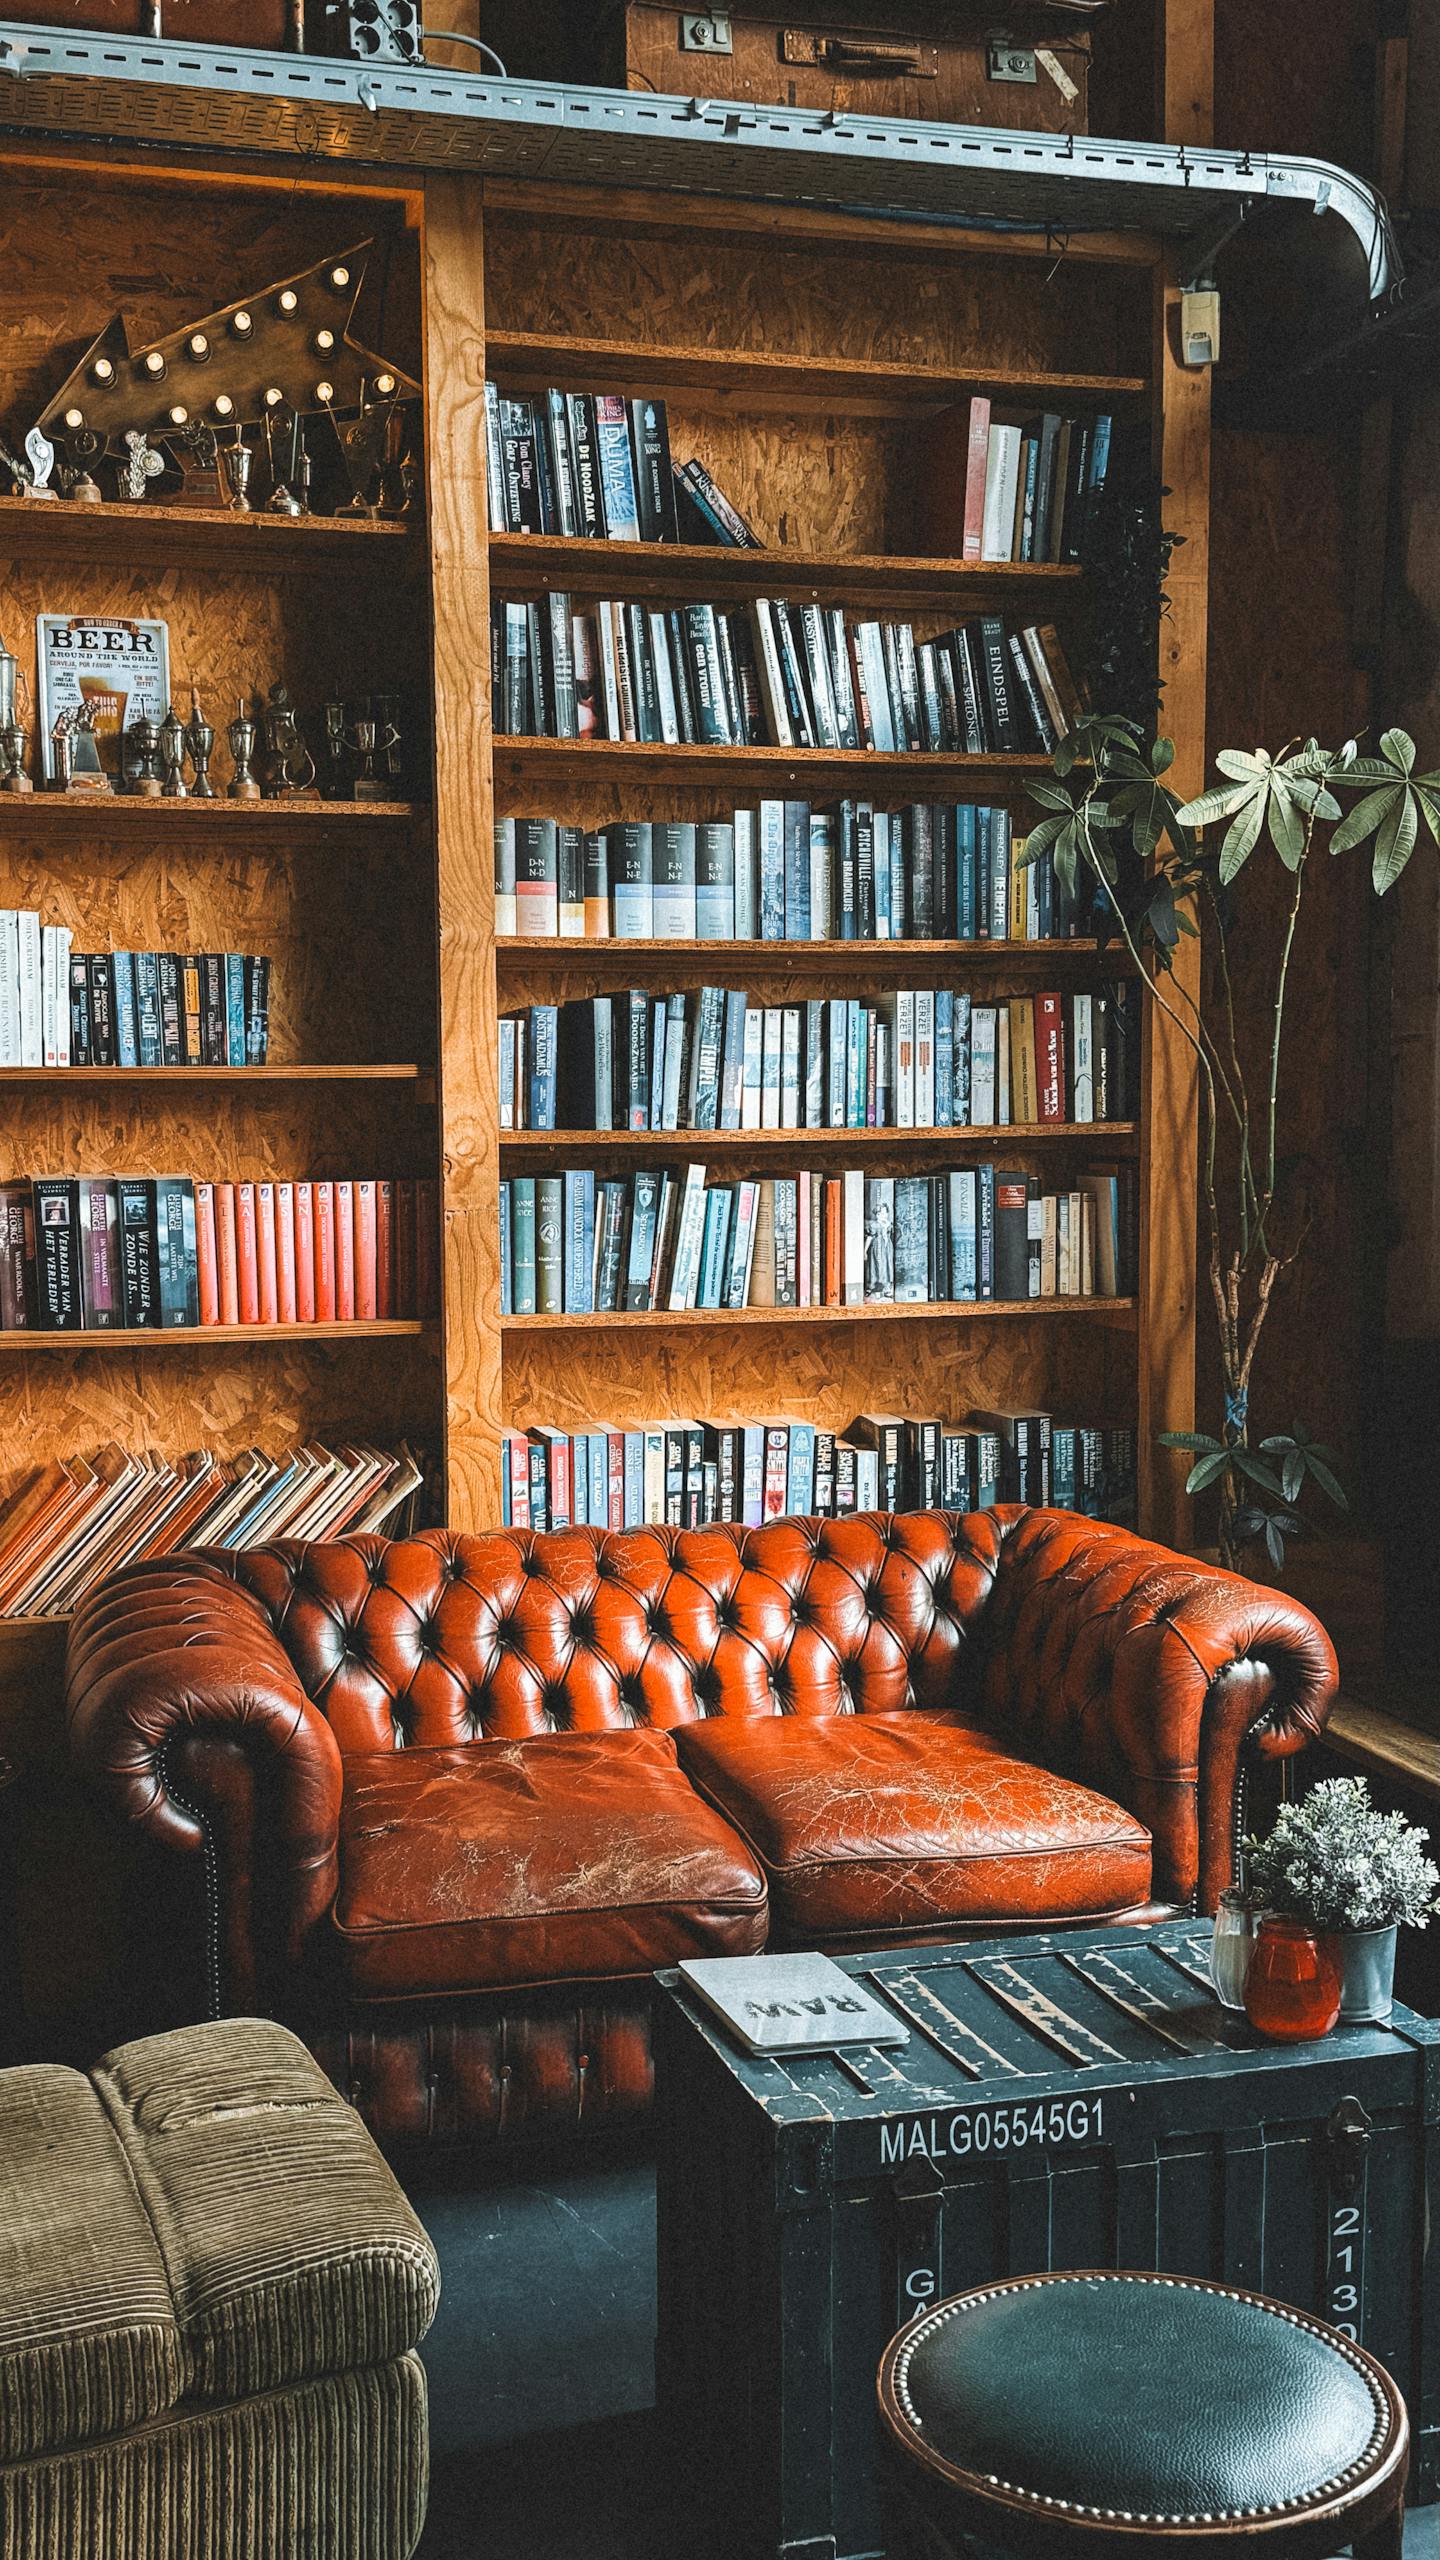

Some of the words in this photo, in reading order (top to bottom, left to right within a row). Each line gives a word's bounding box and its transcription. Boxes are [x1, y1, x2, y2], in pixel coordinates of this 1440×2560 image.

[600, 409, 622, 418] KING
[518, 440, 531, 459] Tom
[604, 427, 626, 492] DUMA
[519, 460, 533, 490] Clancy
[49, 629, 155, 653] BEER
[804, 610, 816, 654] FORSYTH
[49, 651, 93, 660] AROUND
[96, 653, 118, 661] THE
[695, 644, 706, 667] een
[698, 669, 710, 708] vrouw
[989, 646, 1009, 727] EINDSPEL
[861, 695, 871, 729] EINDSPEL
[963, 686, 977, 738] SPELONK
[529, 858, 545, 867] D-N
[626, 861, 641, 869] E-N
[668, 862, 683, 871] F-N
[708, 863, 723, 871] E-N
[858, 828, 871, 880] PSYCHOVILLE
[529, 868, 546, 877] N-D
[627, 871, 641, 879] N-E
[668, 872, 683, 880] N-F
[842, 861, 853, 912] BRANDKLUIS
[568, 890, 576, 899] N
[892, 864, 904, 920] IJSSTATION
[115, 960, 125, 995] GRISHAM
[124, 965, 132, 987] JOHN
[138, 960, 147, 996] GRISHAM
[147, 966, 155, 987] JOHN
[160, 958, 169, 996] GRISHAM
[168, 964, 176, 986] JOHN
[206, 958, 218, 976] JOHN
[228, 955, 240, 973] JOHN
[93, 989, 100, 997] DE
[144, 996, 153, 1013] THE
[209, 977, 218, 1005] GRISHAM
[231, 975, 241, 1005] GRISHAM
[94, 1000, 102, 1023] DUIVEL
[122, 1004, 134, 1049] RAINMAKER
[142, 1014, 157, 1039] CLIENT
[208, 1012, 216, 1042] CHAMBER
[640, 1014, 645, 1024] DE
[710, 992, 718, 1039] MATTHEW
[918, 999, 926, 1035] VERZET
[536, 1012, 546, 1076] NOSTRADAMUS
[631, 1014, 639, 1090] DOODSZWAARD
[699, 1044, 717, 1086] TEMPEL
[574, 1176, 583, 1206] GRAHAM
[785, 1182, 793, 1226] CATHERINE
[9, 1207, 18, 1245] GEORGE
[91, 1194, 100, 1231] GEORGE
[167, 1194, 177, 1231] GEORGE
[298, 1206, 308, 1216] N
[574, 1208, 583, 1239] HANCOCK
[45, 1230, 55, 1251] HET
[100, 1238, 107, 1247] IN
[125, 1233, 137, 1275] ZONDE
[138, 1230, 150, 1254] WIE
[59, 1230, 69, 1287] VERRADER
[100, 1248, 109, 1287] VOLMAAKTE
[573, 1240, 584, 1290] ONDERWERELD
[47, 1256, 58, 1313] VERLEDEN
[139, 1259, 150, 1308] ZONDER
[61, 1291, 71, 1312] VAN
[885, 1429, 897, 1464] LUDLUM
[924, 1426, 935, 1461] LUDLUM
[1018, 1422, 1027, 1456] LUDLUM
[1042, 1418, 1050, 1449] LUDLUM
[531, 1454, 539, 1482] CUSSLER
[626, 1444, 634, 1477] CUSSLER
[634, 1448, 642, 1471] CLIVE
[817, 1435, 825, 1472] SMITH
[823, 1435, 832, 1472] WILBUR
[846, 1451, 854, 1483] WILBUR
[980, 1437, 988, 1488] dubbelspel
[986, 1456, 994, 1482] Jason
[612, 1497, 621, 1525] GOUDEN
[743, 1994, 868, 2019] RAW
[880, 2097, 1103, 2164] MALG05545G1
